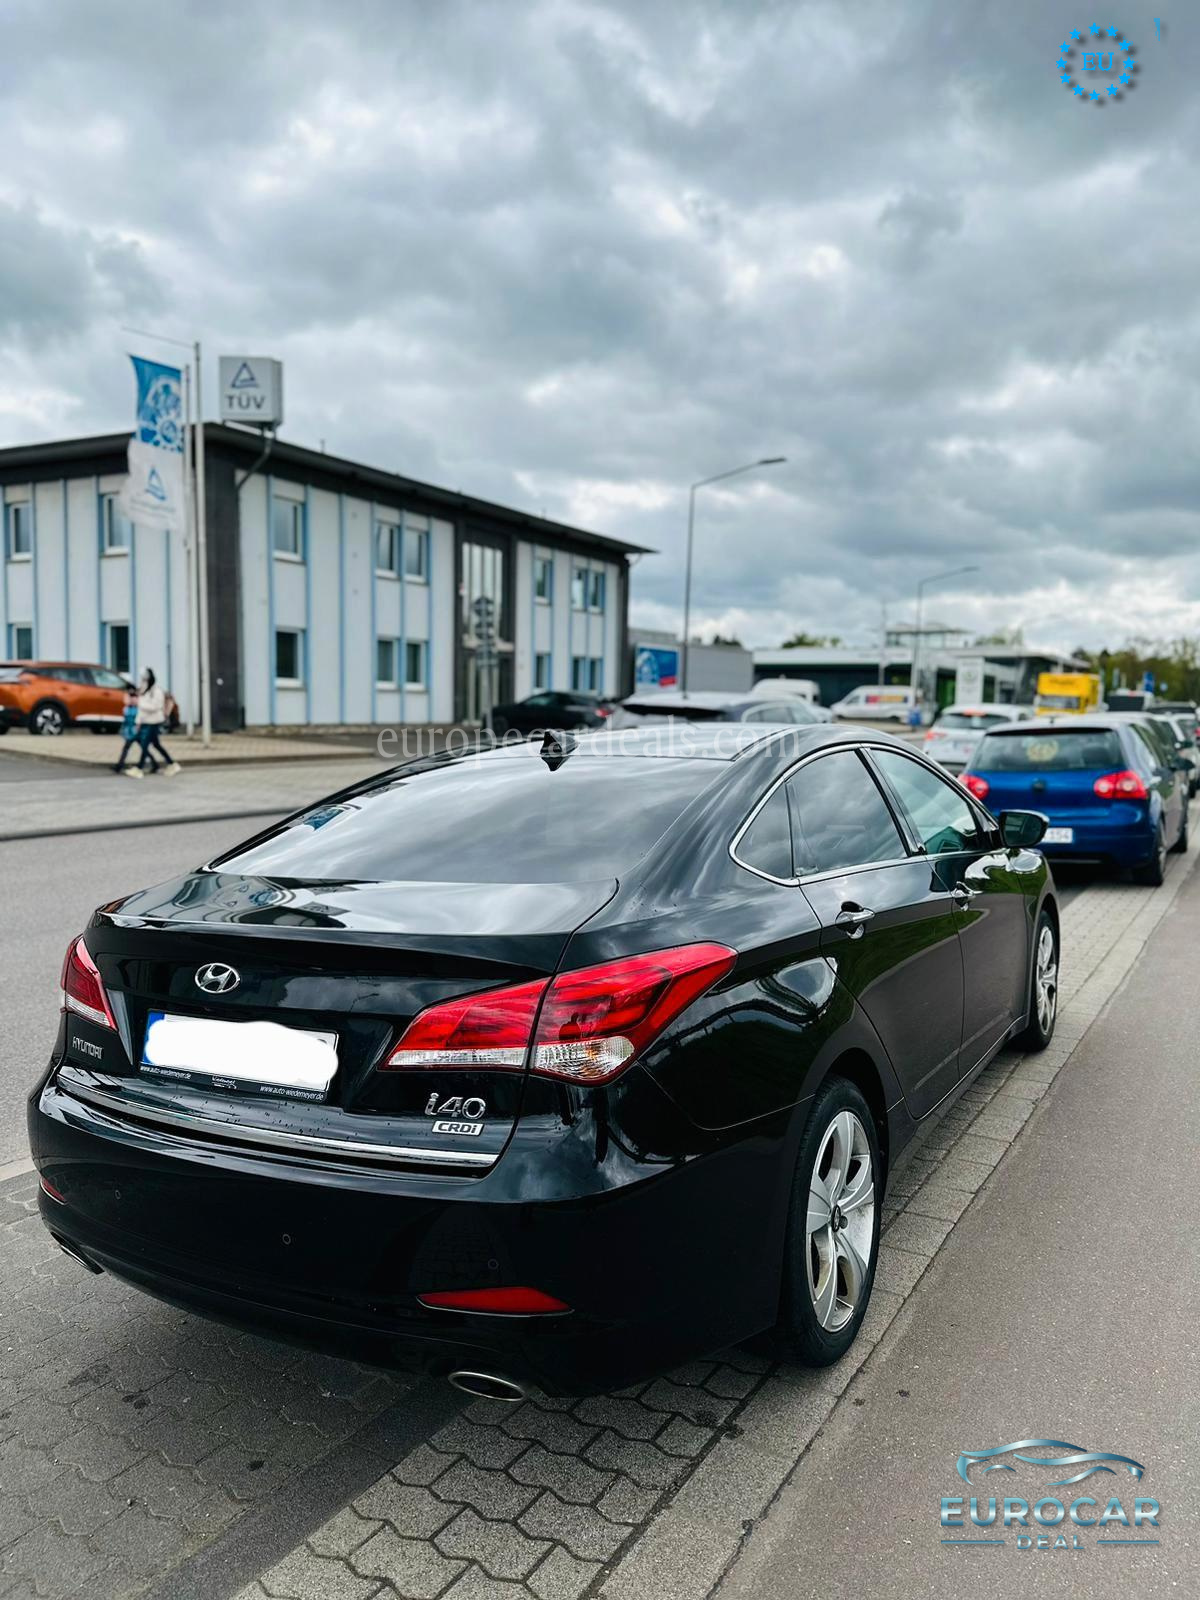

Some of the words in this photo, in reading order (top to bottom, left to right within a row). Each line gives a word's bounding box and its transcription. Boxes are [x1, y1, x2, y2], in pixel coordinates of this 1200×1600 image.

[225, 391, 266, 410] TÜV
[72, 1036, 103, 1060] HYUNDAI
[260, 1084, 324, 1100] www.auto-wiedemeyer.de
[424, 1092, 487, 1120] i40
[438, 1122, 478, 1134] CRDi
